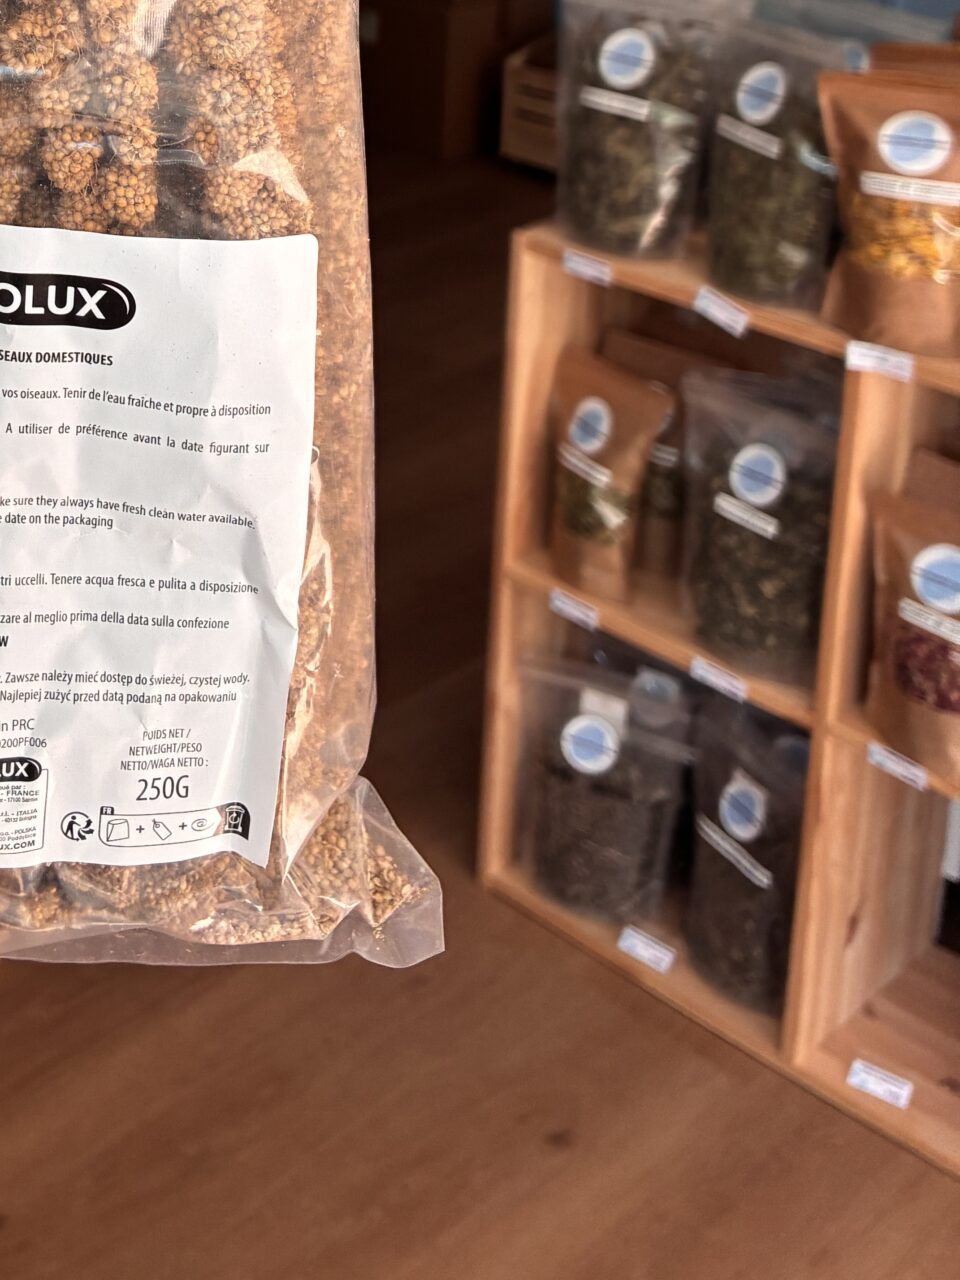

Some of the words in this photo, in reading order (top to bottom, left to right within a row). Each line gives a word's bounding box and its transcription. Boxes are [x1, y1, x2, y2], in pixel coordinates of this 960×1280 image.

[36, 352, 113, 365] DOMESTIQUES
[2, 388, 18, 398] vos
[21, 389, 61, 399] oiseaux.
[63, 388, 86, 398] Tenir
[89, 389, 101, 400] de
[128, 395, 161, 410] fraîche
[164, 402, 173, 411] et
[176, 404, 208, 418] propre
[211, 406, 216, 416] à
[219, 404, 271, 418] disposition
[6, 423, 12, 433] A
[19, 424, 52, 434] utiliser
[58, 424, 70, 433] de
[76, 425, 127, 440] préférence
[133, 434, 161, 445] avant
[167, 437, 175, 448] la
[182, 440, 203, 452] date
[209, 442, 249, 455] figurant
[255, 443, 269, 453] sur
[13, 497, 33, 505] sure
[37, 496, 58, 508] they
[60, 497, 94, 508] always
[97, 499, 119, 511] have
[122, 502, 146, 516] fresh
[149, 508, 174, 519] clean
[178, 511, 206, 522] water
[209, 514, 255, 529] available.
[6, 672, 39, 683] Zawsze
[42, 670, 73, 685] należy
[75, 671, 98, 683] mieć
[100, 672, 132, 686] dostęp
[135, 673, 147, 685] do
[150, 675, 187, 687] świeżej,
[189, 674, 221, 687] czystej
[224, 673, 250, 685] wody.
[12, 719, 35, 731] PRC
[129, 743, 202, 756] NETWEIGHT/PESO
[120, 760, 175, 770] NETTO/WAGA
[178, 757, 203, 767] NETTO
[136, 775, 189, 801] 250G
